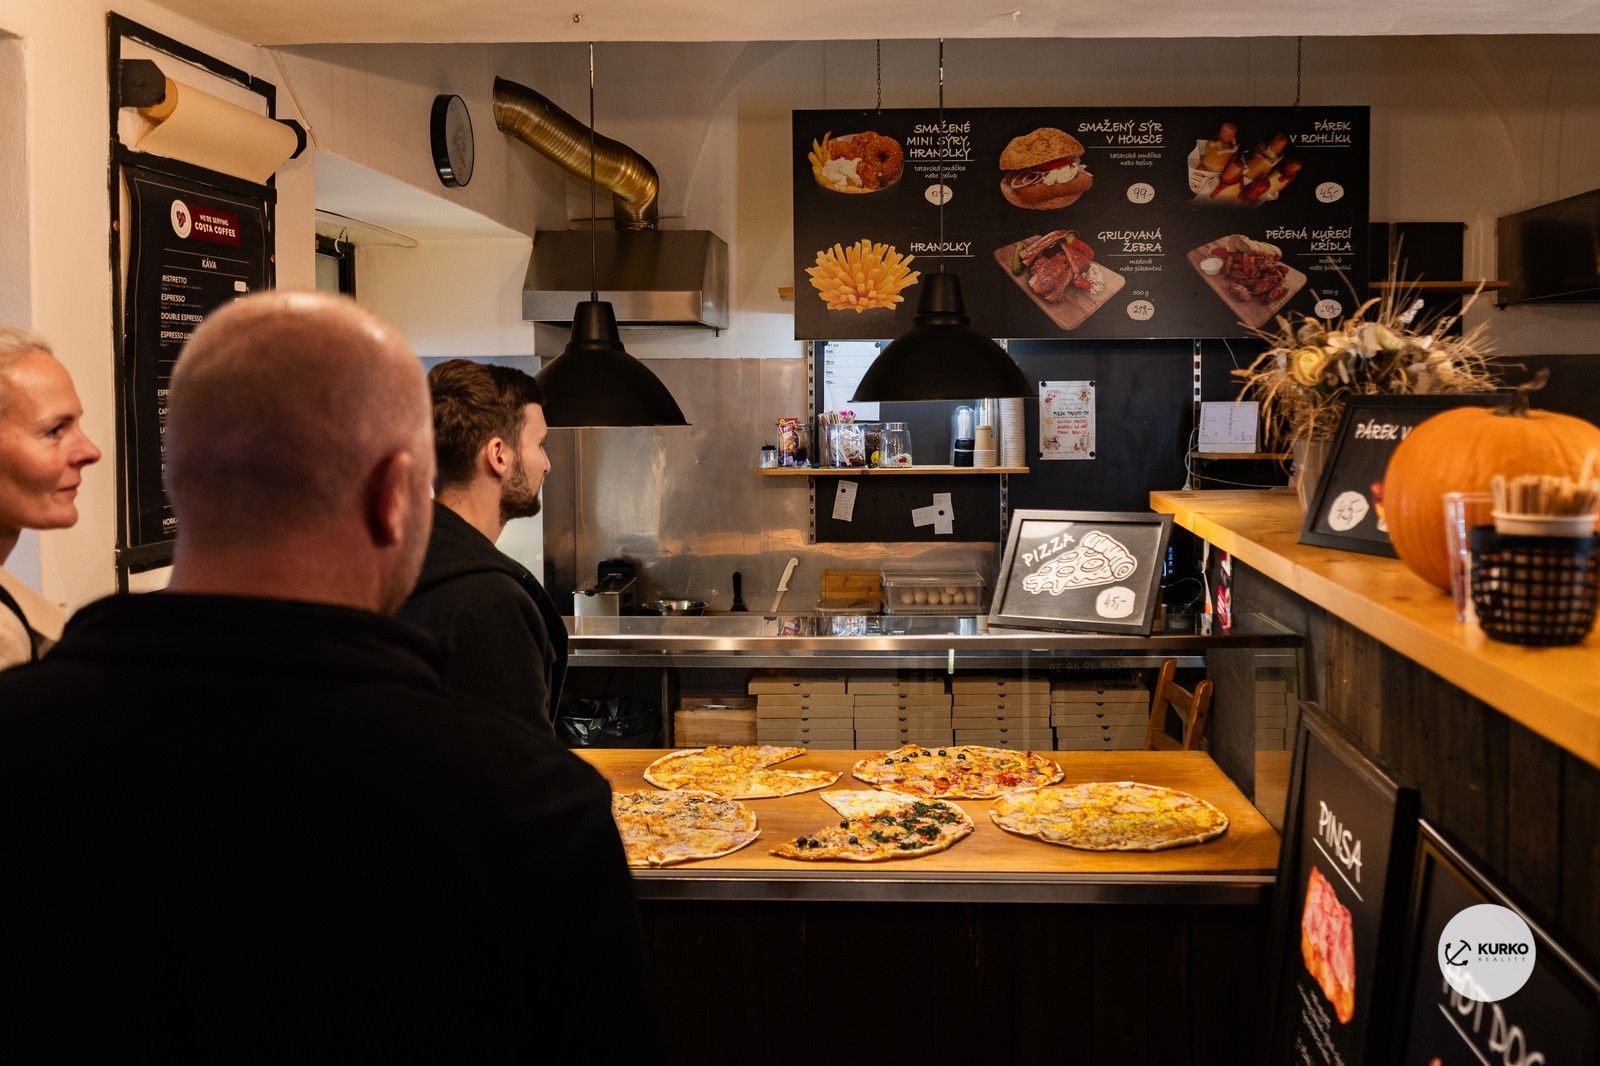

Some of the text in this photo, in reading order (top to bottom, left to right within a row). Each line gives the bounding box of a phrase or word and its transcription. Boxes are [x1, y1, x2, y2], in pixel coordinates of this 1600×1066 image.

[914, 120, 971, 134] SMAŽENÉ
[1077, 119, 1163, 137] SMAŽENÝ SÝR
[1314, 119, 1351, 131] PÁREK
[907, 137, 932, 146] MINI
[1106, 134, 1163, 144] V HOUSCE
[1290, 133, 1352, 143] V ROHLÍKU
[909, 148, 971, 160] HRANOLKY
[194, 221, 236, 238] COSTA COFFEE
[1097, 227, 1162, 241] GRILOVANÁ
[1265, 225, 1353, 241] PEČENÁ KUŘECÍ
[910, 241, 971, 256] HRANOLKY
[1122, 239, 1162, 253] ŽEBRA
[1310, 238, 1352, 252] KŘÍDLA
[201, 258, 217, 270] KÁVA
[162, 274, 188, 285] RISTRETTO
[160, 293, 186, 303] ESPRESSO
[160, 312, 203, 323] DOUBLE ESPRESSO
[160, 331, 184, 340] ESPRESSO
[1354, 418, 1400, 440] PÁREK
[1021, 532, 1075, 567] PIZZA
[1318, 799, 1363, 884] PINSA
[1487, 1002, 1546, 1066] DO
